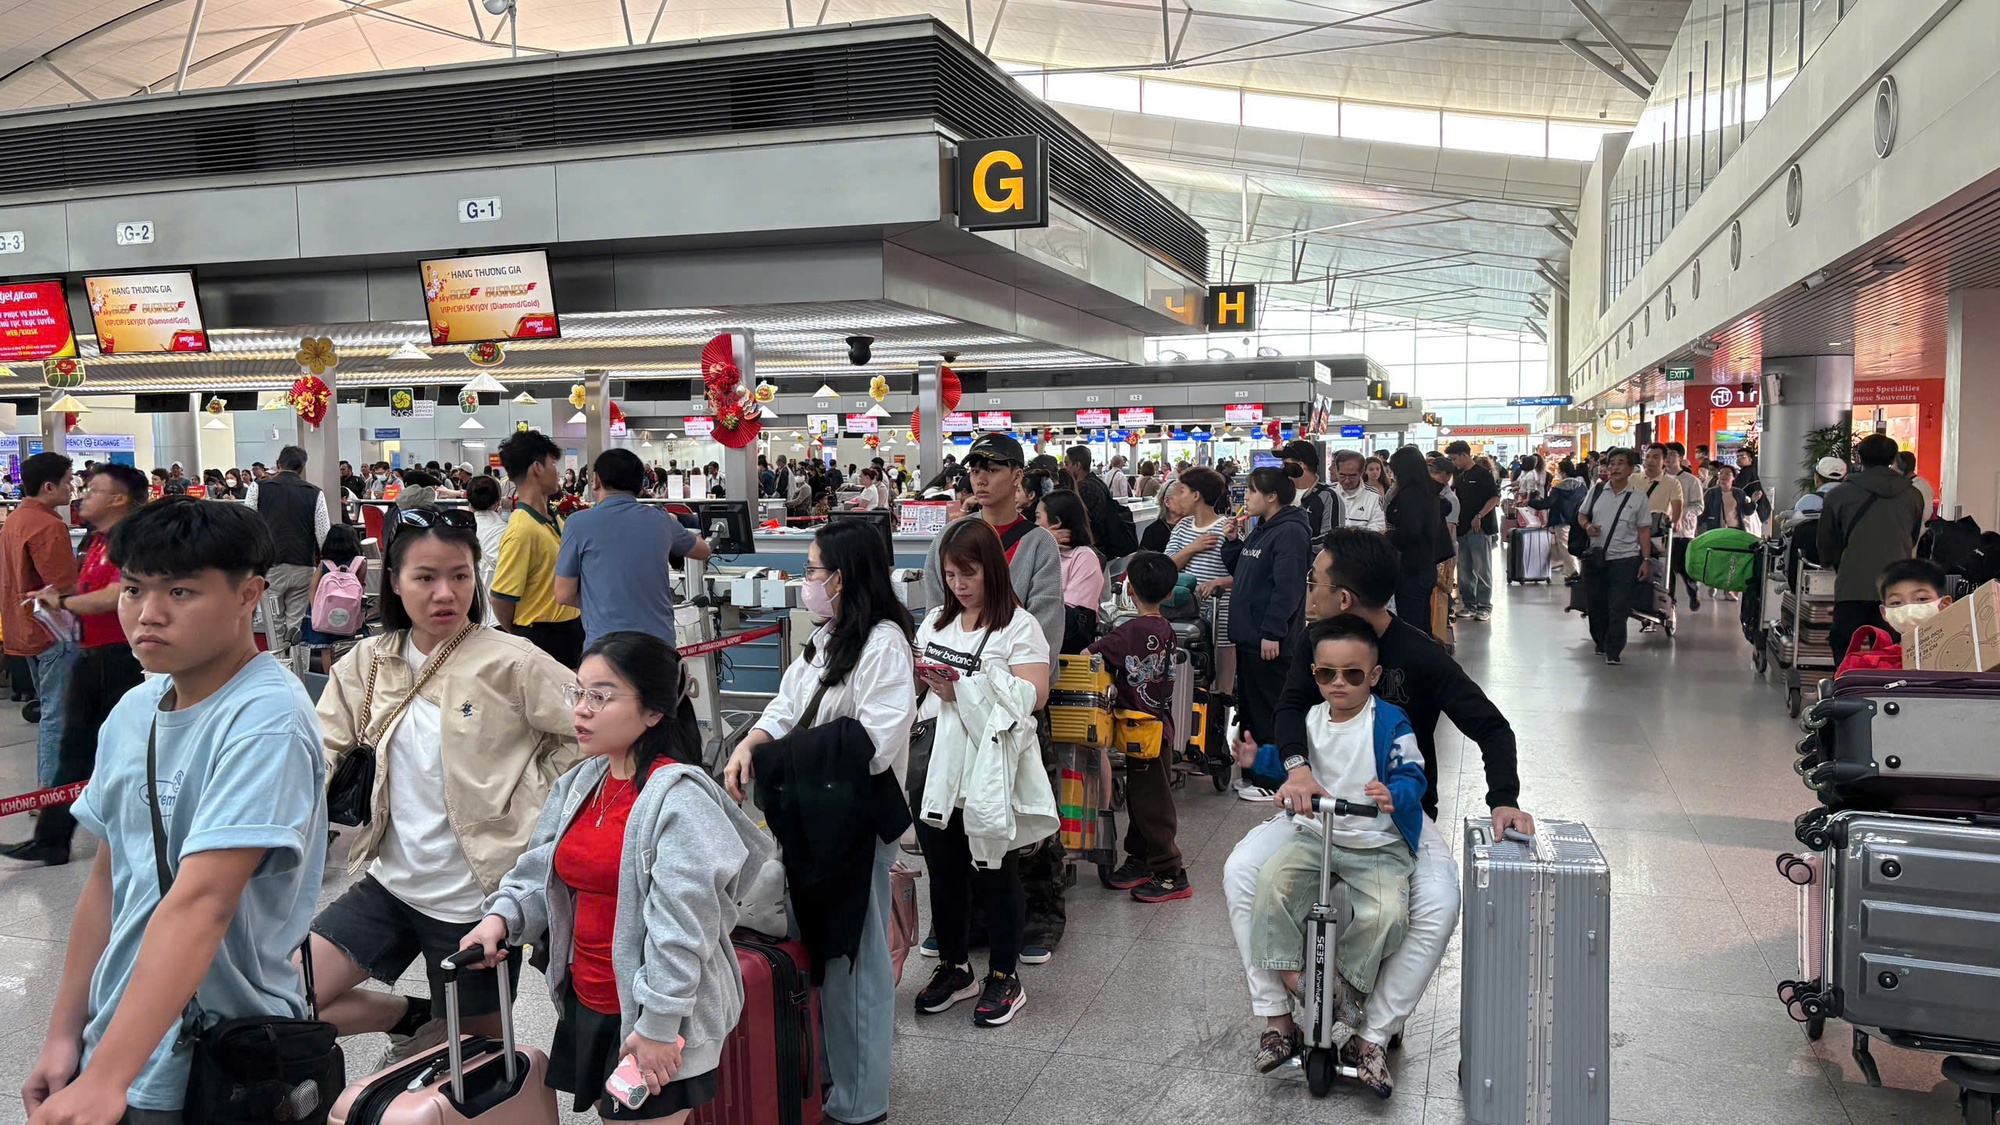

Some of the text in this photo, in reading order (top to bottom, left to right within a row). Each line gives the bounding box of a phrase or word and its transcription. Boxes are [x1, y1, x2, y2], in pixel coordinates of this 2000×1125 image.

[972, 150, 1024, 213] G
[466, 200, 494, 219] G-1
[124, 225, 150, 241] G-2
[0, 235, 21, 250] G-3
[508, 266, 522, 275] GIA
[160, 285, 172, 293] GIA
[1218, 291, 1245, 324] H
[1669, 370, 1686, 379] EXIT
[1376, 383, 1382, 398] I
[1875, 385, 1920, 394] Specialties
[1394, 394, 1405, 407] J
[391, 409, 414, 417] SAGS
[1425, 413, 1433, 423] K
[93, 439, 120, 447] EXCHANGE
[927, 645, 980, 668] new balanc
[40, 787, 66, 805] QUỐC
[68, 784, 82, 799] TẾ
[1315, 936, 1325, 964] SE3S
